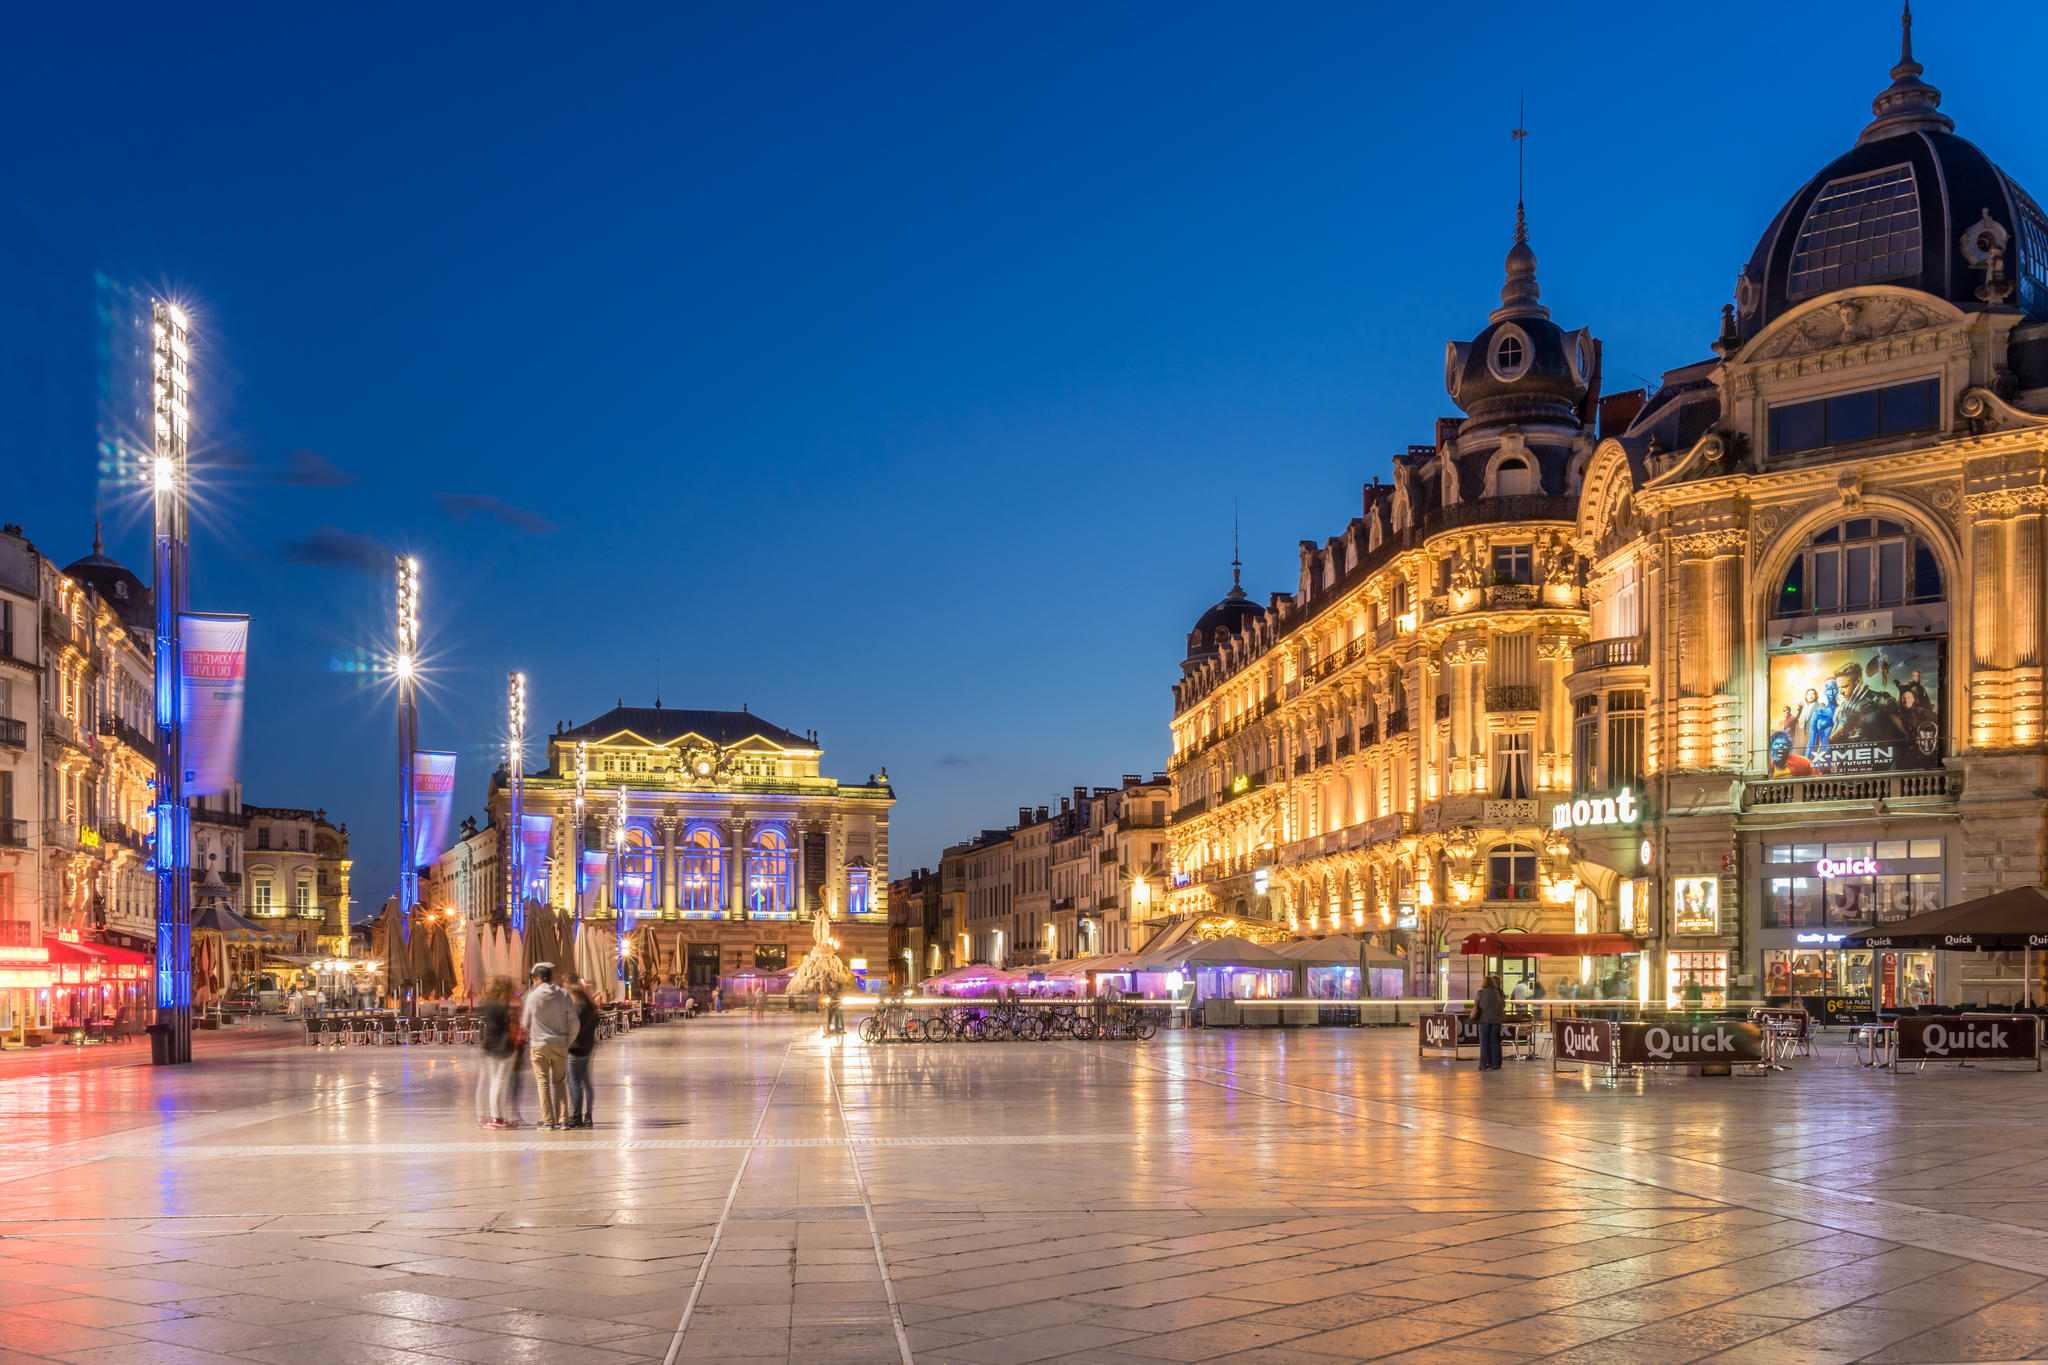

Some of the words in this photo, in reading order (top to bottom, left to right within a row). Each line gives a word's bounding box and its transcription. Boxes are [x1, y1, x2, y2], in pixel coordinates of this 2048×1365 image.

[1810, 746, 1893, 764] X-MEN
[1553, 787, 1637, 830] mont
[1817, 857, 1878, 878] Quick
[1828, 880, 1938, 918] Quick
[1866, 938, 1892, 947] Quick
[1944, 935, 1973, 945] Quick
[2029, 935, 2048, 945] Qui
[1426, 1019, 1449, 1044] Quick
[1564, 1025, 1599, 1056] Quick
[1645, 1027, 1735, 1059] Quick
[1922, 1023, 2009, 1055] Quick
